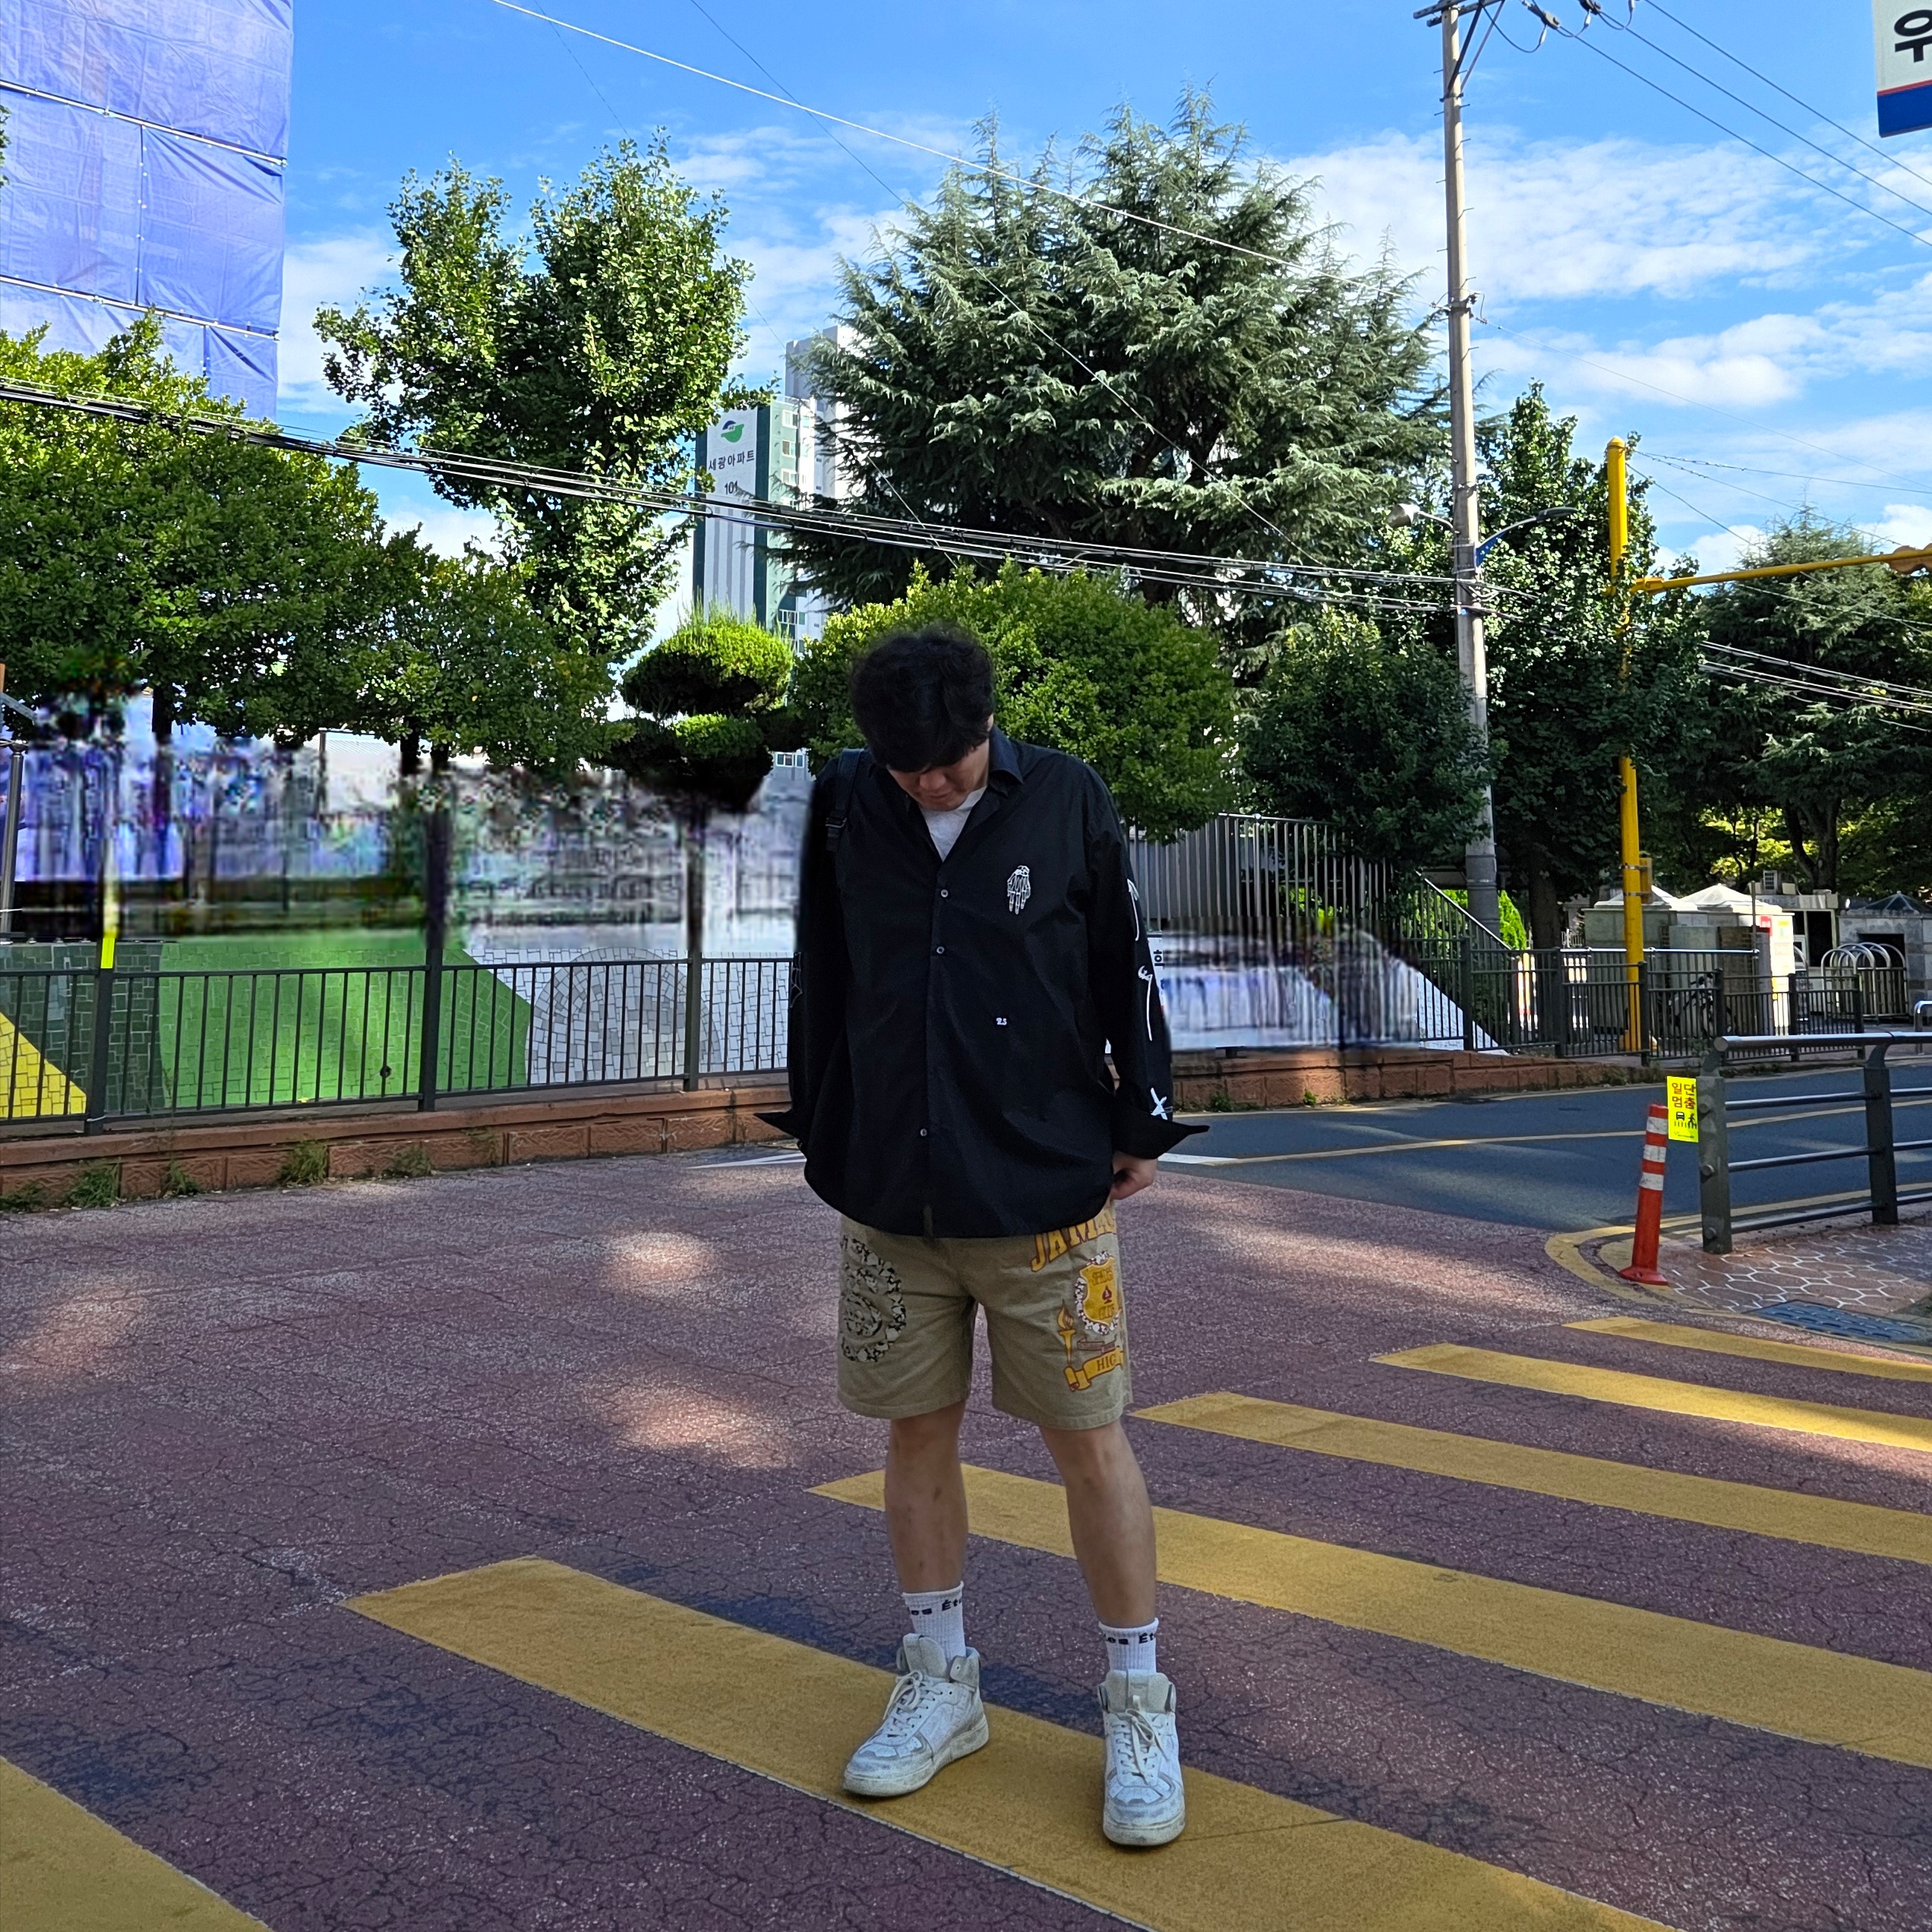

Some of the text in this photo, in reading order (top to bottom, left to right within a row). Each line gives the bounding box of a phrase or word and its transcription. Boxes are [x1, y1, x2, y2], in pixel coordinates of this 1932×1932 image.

[709, 450, 754, 471] 세광아파트
[1672, 1082, 1696, 1096] 일단
[1672, 1096, 1696, 1110] 멈춤
